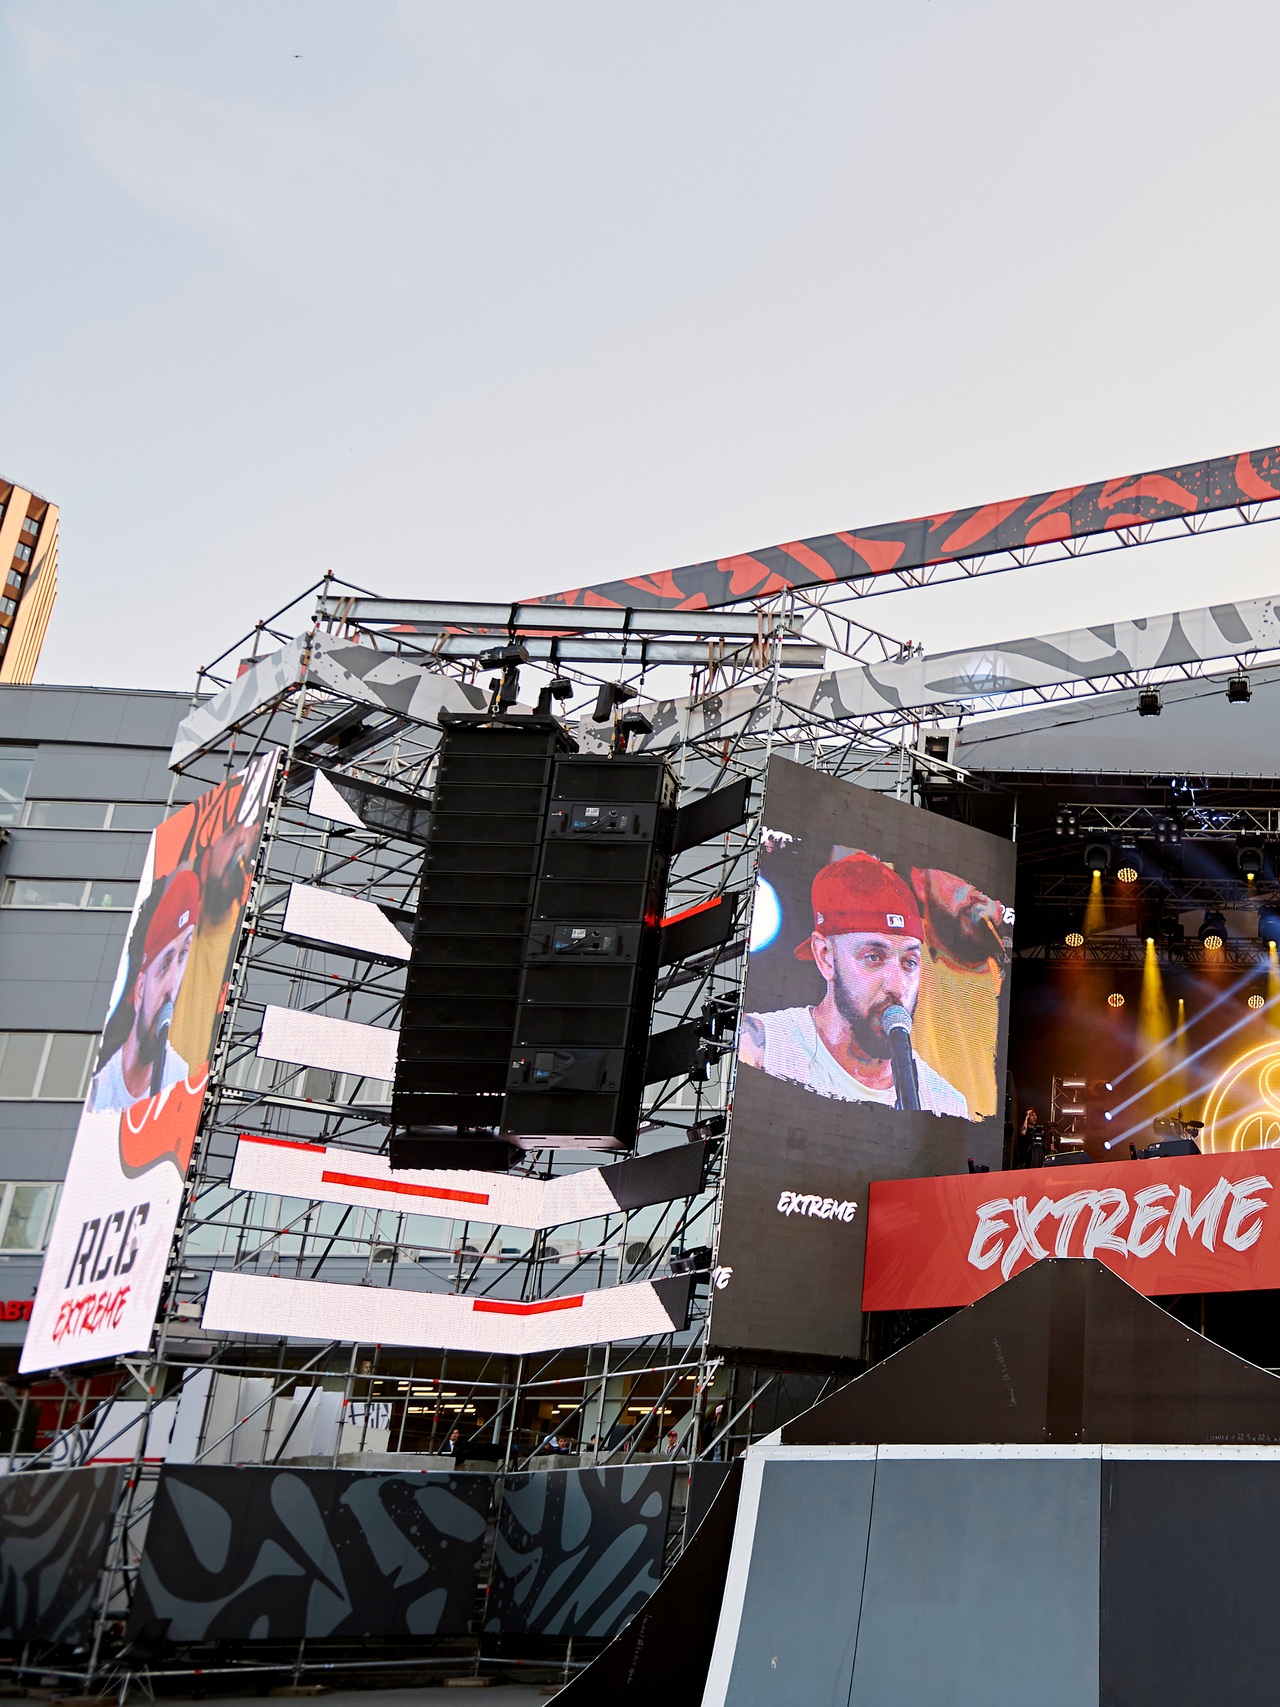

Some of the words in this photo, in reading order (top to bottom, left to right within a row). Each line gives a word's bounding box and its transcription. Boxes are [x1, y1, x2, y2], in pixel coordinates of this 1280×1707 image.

[777, 1191, 858, 1222] EXTREME
[968, 1175, 1273, 1280] EXTREME
[65, 1203, 150, 1289] RCC
[53, 1286, 131, 1346] EXTREME
